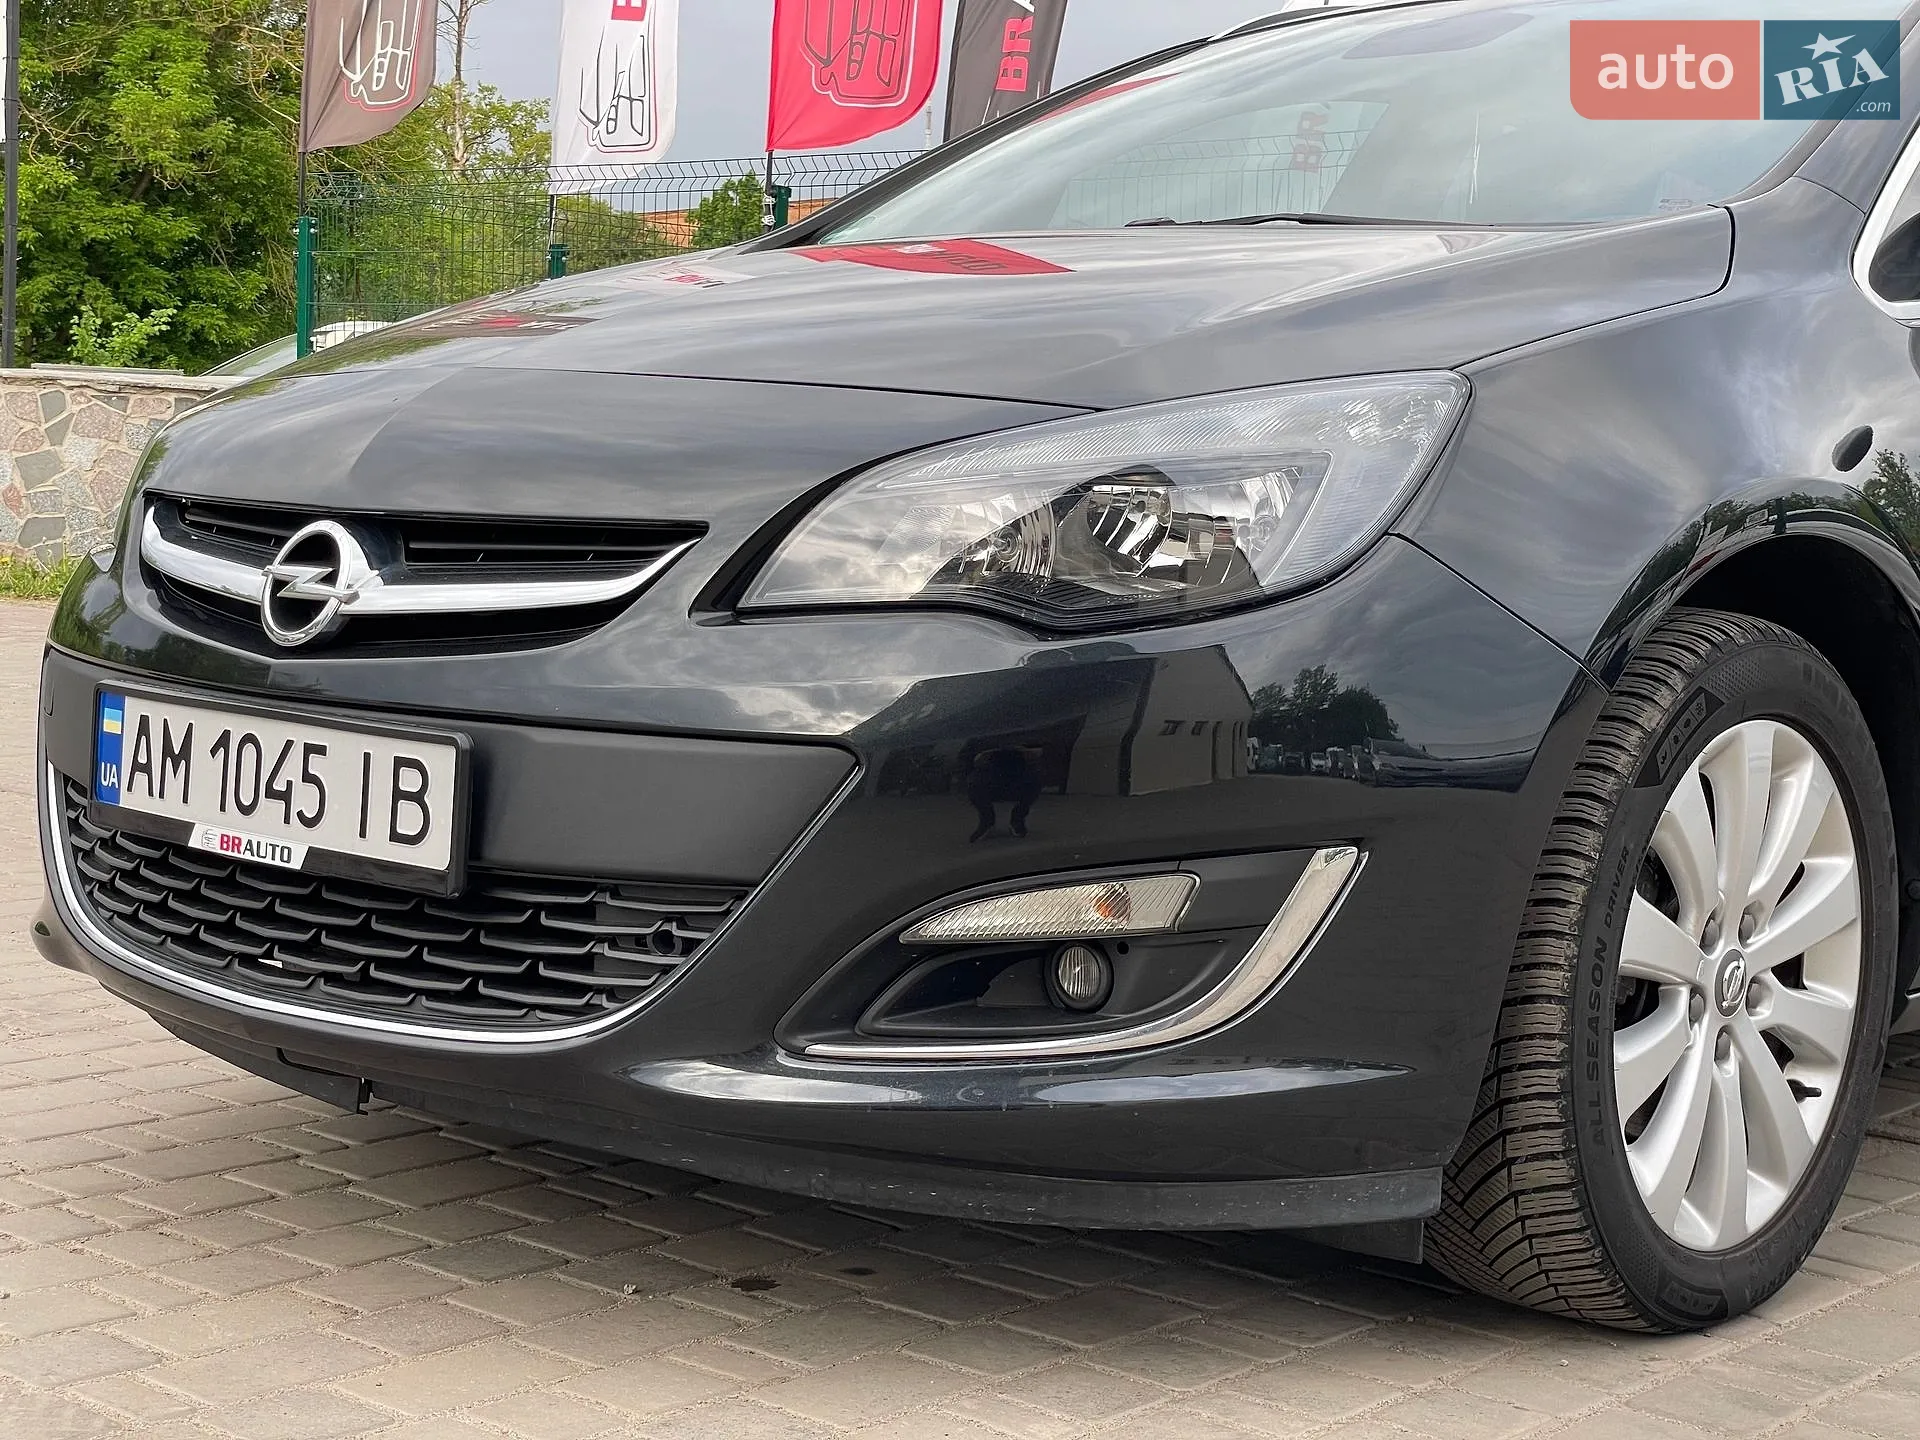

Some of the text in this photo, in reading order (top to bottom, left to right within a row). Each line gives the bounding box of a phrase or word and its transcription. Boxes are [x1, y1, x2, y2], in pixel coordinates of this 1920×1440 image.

[100, 762, 119, 788] UA
[126, 713, 432, 847] AM 1045 IB
[219, 832, 292, 864] BRAUTO
[1586, 936, 1608, 1082] SEASON
[1604, 846, 1629, 930] DRIVER
